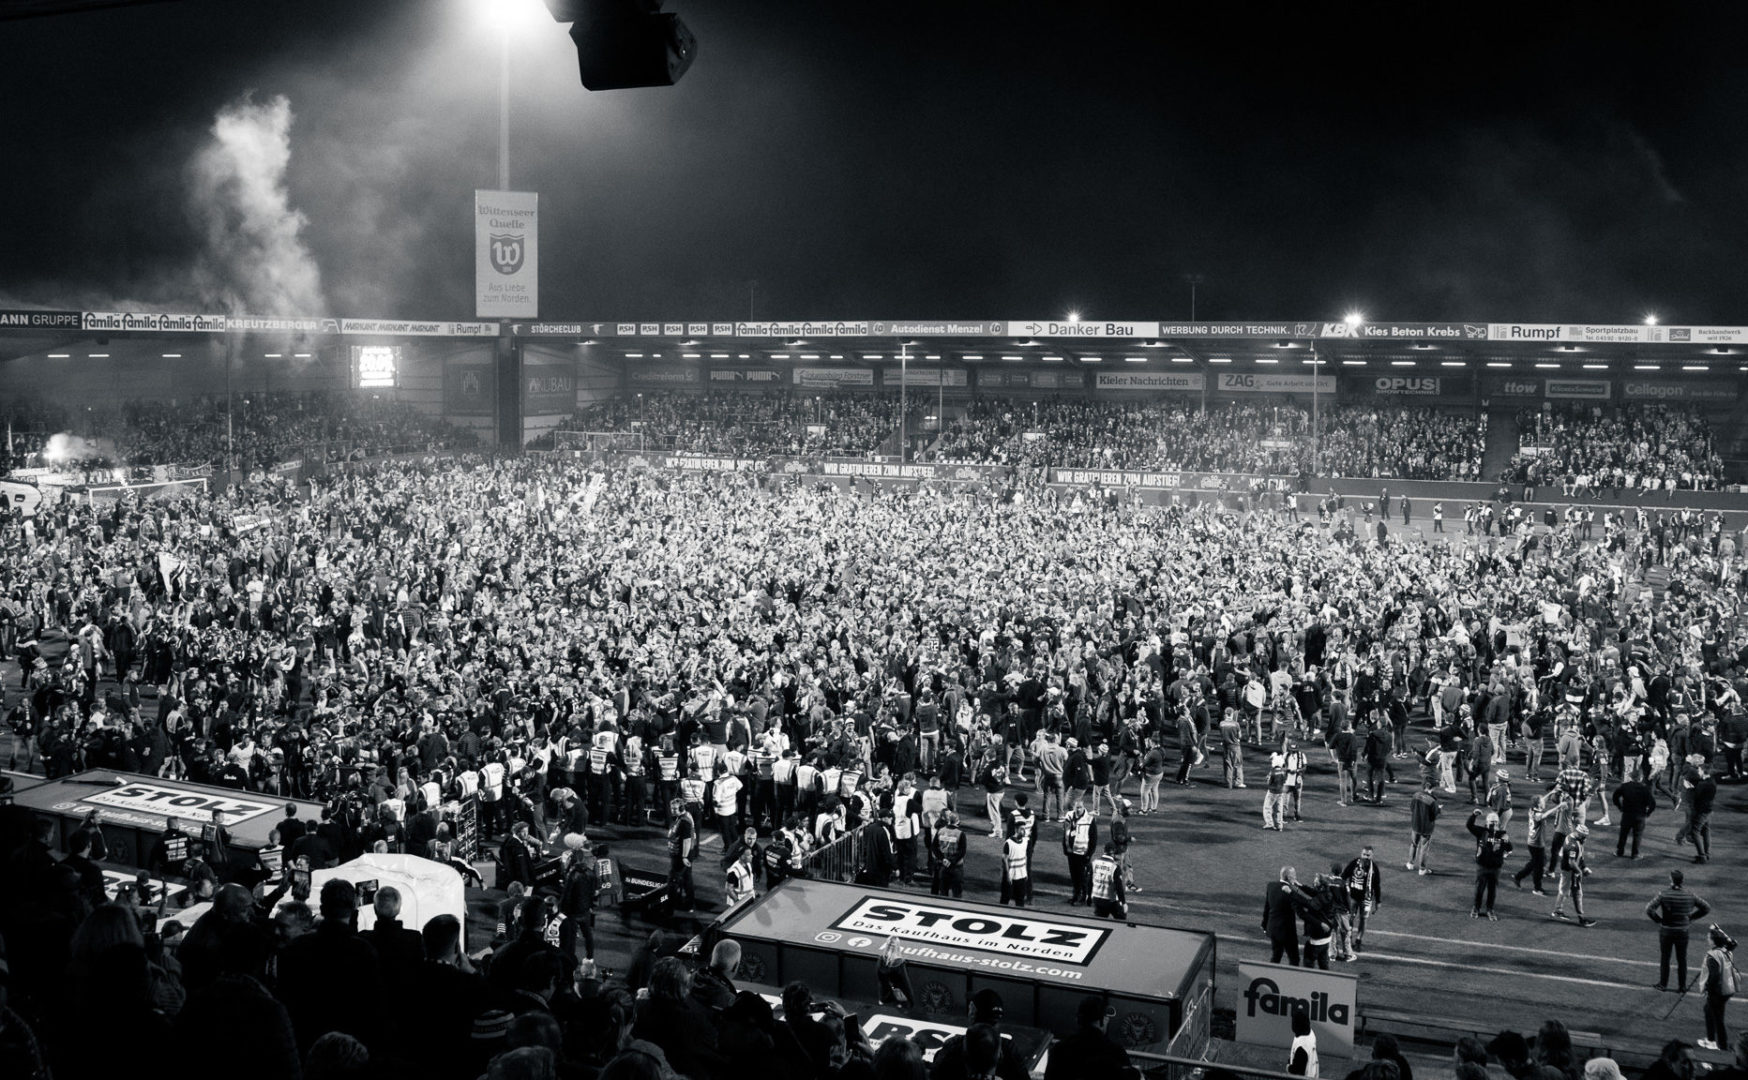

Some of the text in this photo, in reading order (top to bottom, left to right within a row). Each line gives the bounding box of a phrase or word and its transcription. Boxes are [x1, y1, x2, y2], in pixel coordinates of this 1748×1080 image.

[490, 218, 525, 230] Quelle
[488, 282, 526, 292] Aus Liebe
[32, 314, 78, 326] GRUPPE
[83, 313, 224, 332] famila famila famila famila
[227, 319, 317, 330] KREUTZBERGER
[456, 323, 482, 335] Rumpf
[530, 322, 582, 334] STÖRCHECLUB
[736, 322, 867, 336] famila famila famila famila
[890, 323, 945, 334] Autodienst
[947, 323, 983, 334] Menzel
[1049, 322, 1134, 336] Danker Bau
[1162, 325, 1208, 335] WERBUNG
[1211, 325, 1243, 335] DURCH
[1246, 325, 1291, 335] TECHNIK.
[1320, 322, 1360, 338] KBK
[1364, 325, 1460, 337] Kies Beton Krebs
[1511, 325, 1562, 340] Rumpf
[1585, 326, 1639, 335] Sportplatzbau
[710, 371, 772, 381] PUMA PUMA
[1100, 375, 1189, 386] Kieler Nachrichten
[1225, 374, 1255, 387] ZAG
[1375, 377, 1436, 390] OPUS
[1625, 383, 1684, 398] Cellagon
[824, 462, 838, 474] WIR
[839, 463, 882, 476] GRATULIEREN
[883, 464, 899, 476] ZUM
[1057, 470, 1072, 483] WIR
[1123, 473, 1141, 485] ZUM
[111, 787, 264, 817] STOLZ
[862, 905, 1088, 948] STOLZ
[852, 920, 1074, 958] Das Kaufhaus im Norden
[1243, 977, 1349, 1026] famila
